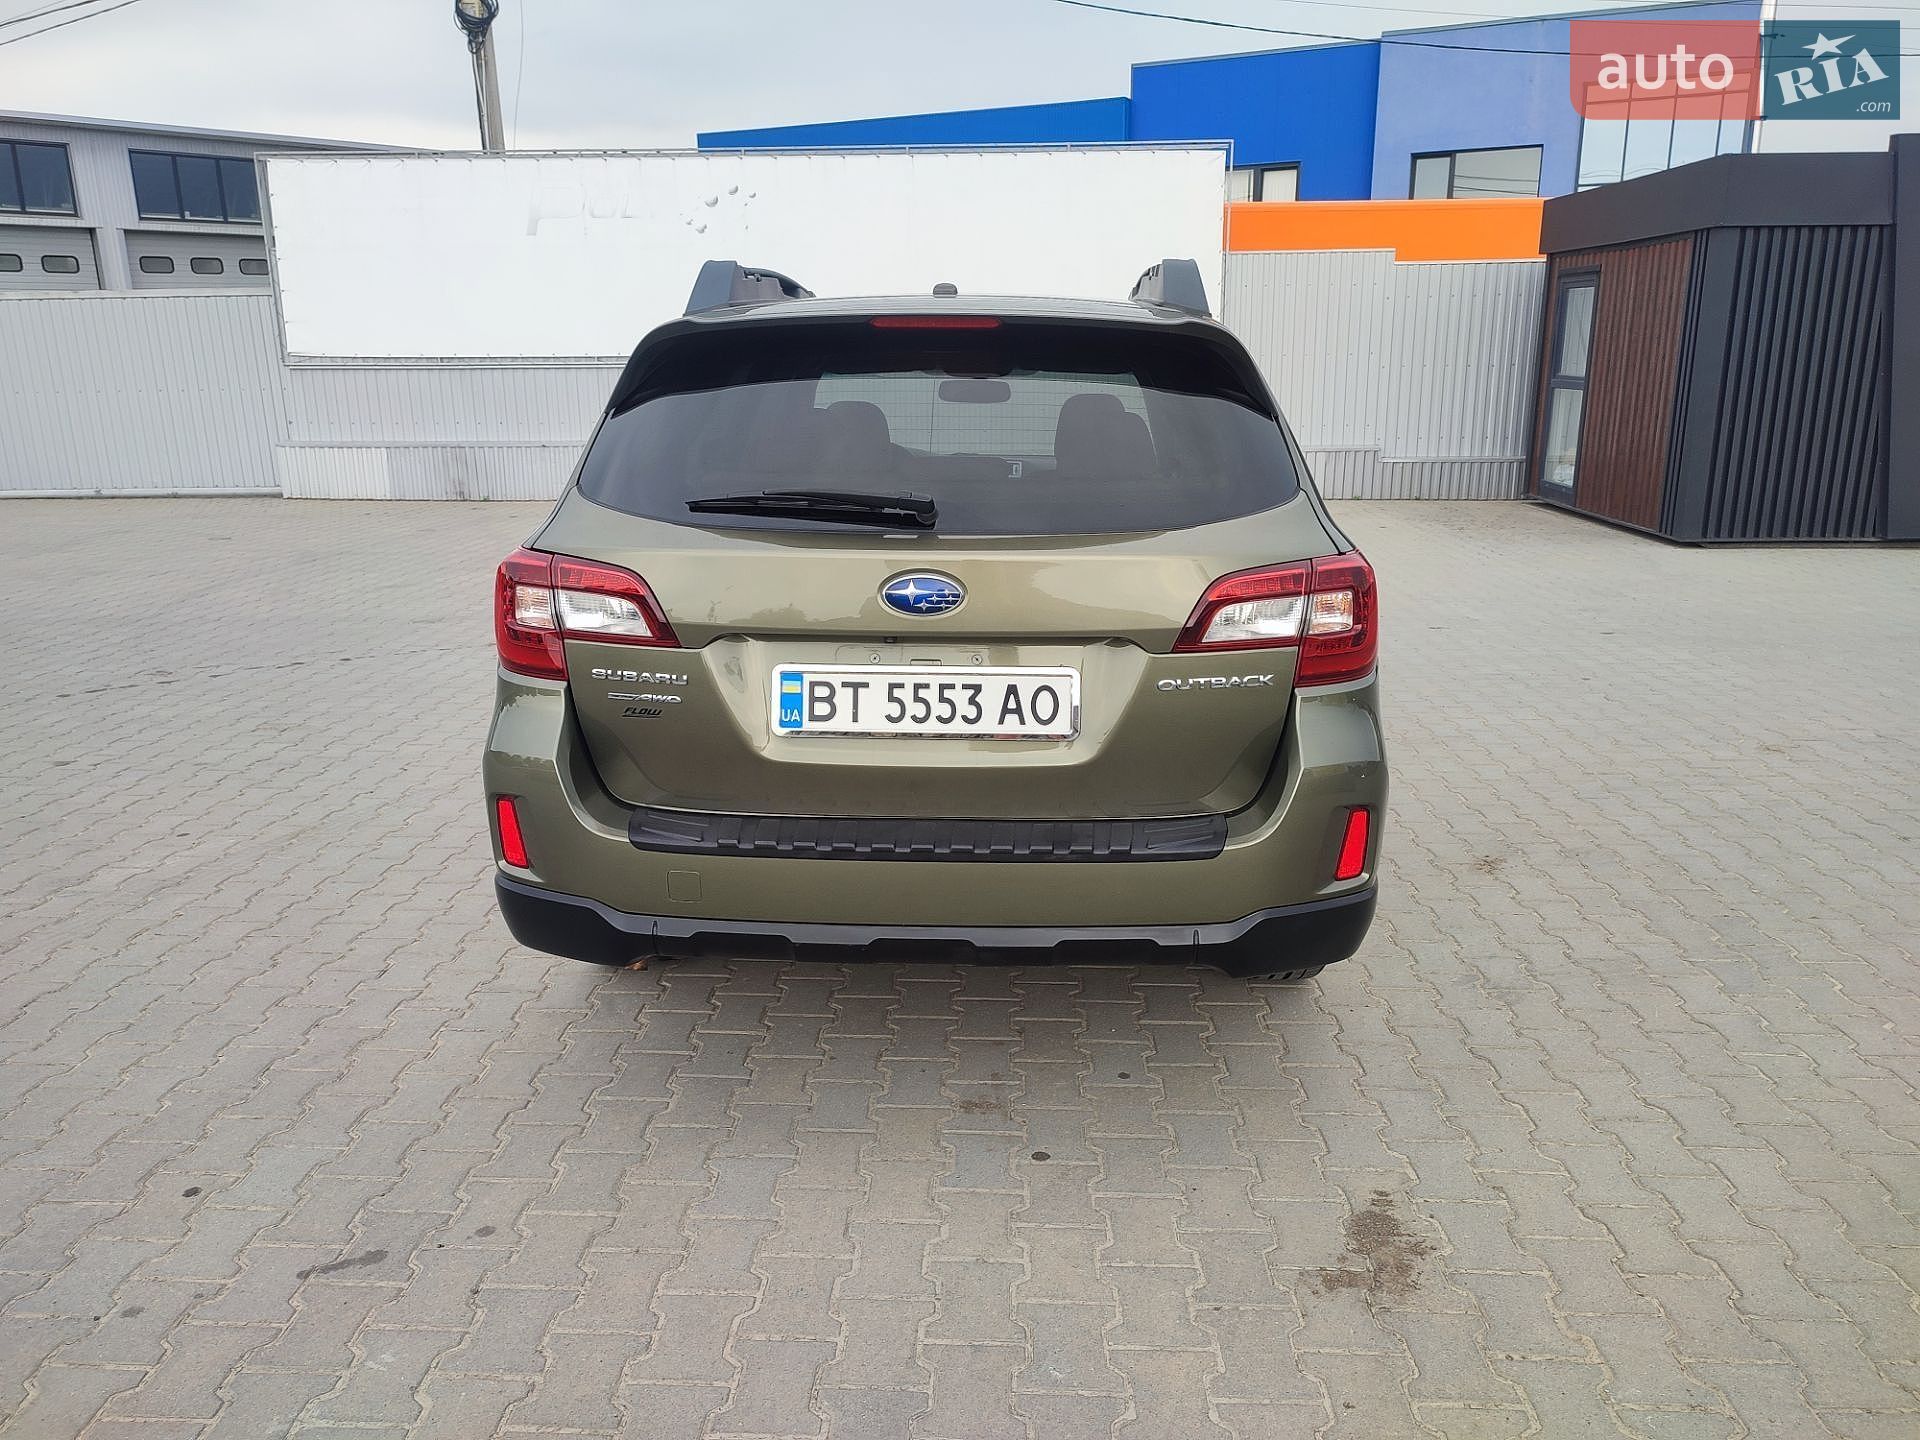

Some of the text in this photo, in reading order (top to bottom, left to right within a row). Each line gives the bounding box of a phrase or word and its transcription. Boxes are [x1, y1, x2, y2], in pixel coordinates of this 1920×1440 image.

[591, 668, 688, 685] SUBARU
[1157, 674, 1275, 691] OUTBACK
[634, 693, 682, 704] AWD
[808, 681, 1060, 726] BT 5553 AO
[624, 707, 662, 716] FLOW
[781, 707, 801, 723] UA
